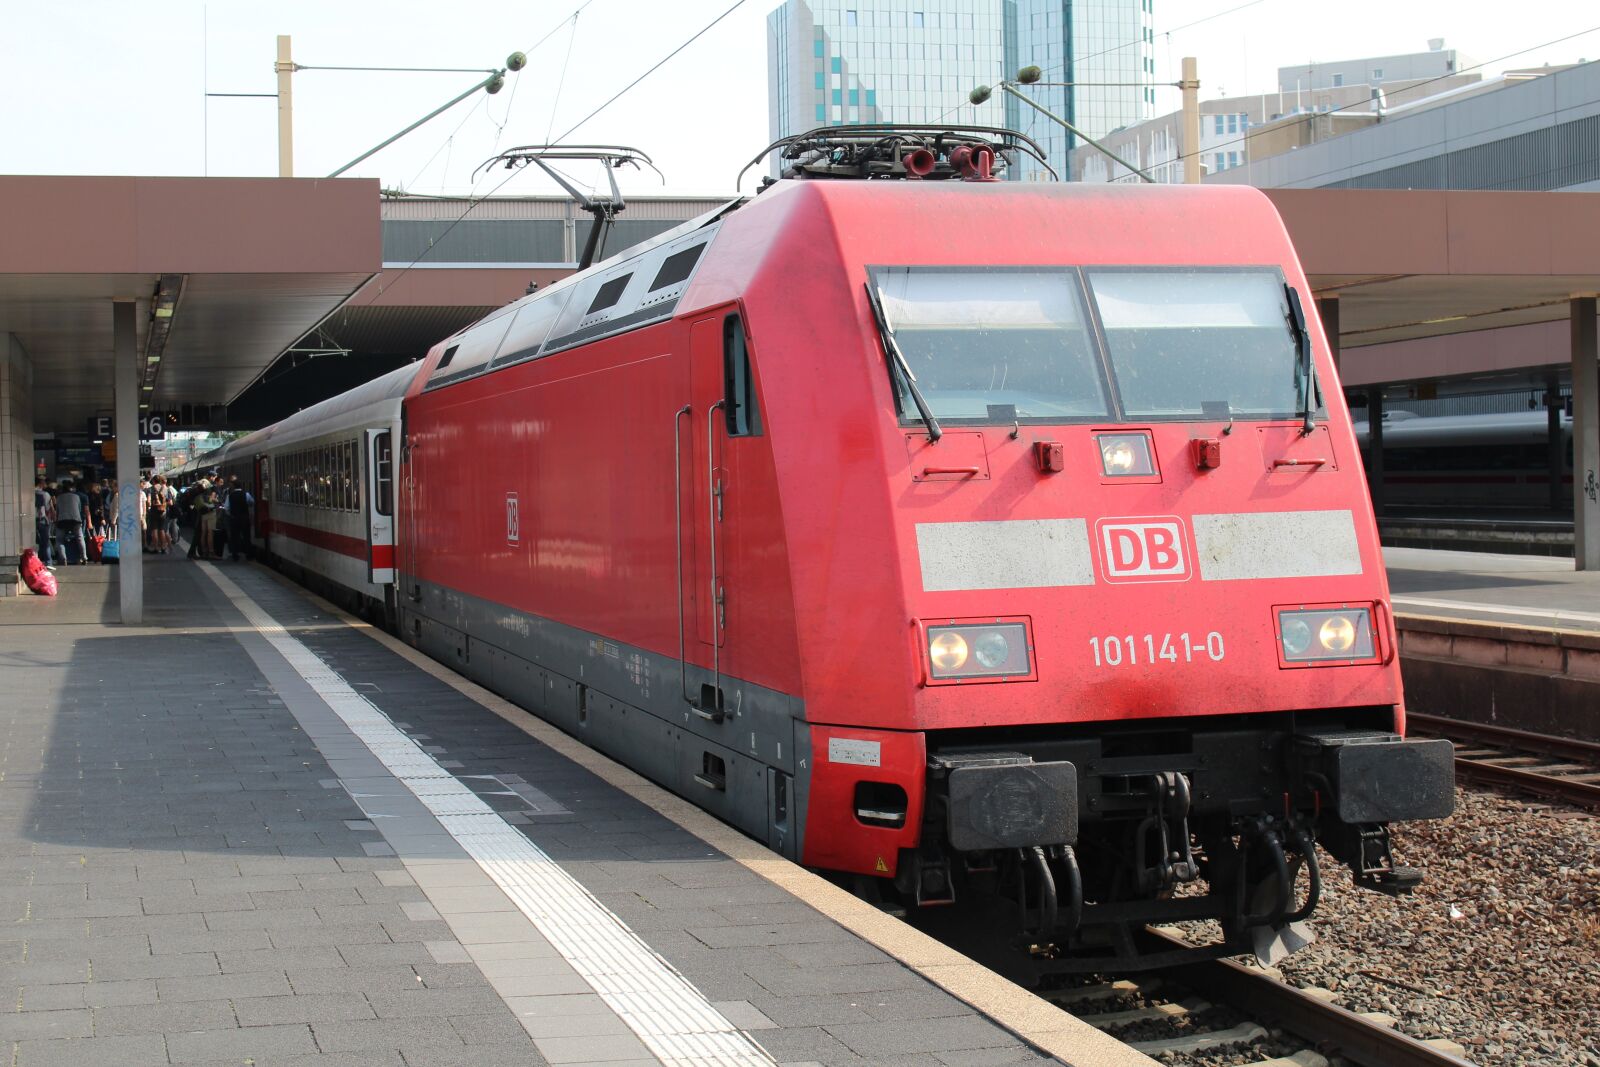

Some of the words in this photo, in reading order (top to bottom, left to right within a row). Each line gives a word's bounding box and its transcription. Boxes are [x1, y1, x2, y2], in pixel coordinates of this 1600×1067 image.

[97, 417, 110, 436] E
[139, 416, 162, 436] 16
[1108, 527, 1179, 571] DB
[736, 689, 742, 717] 2
